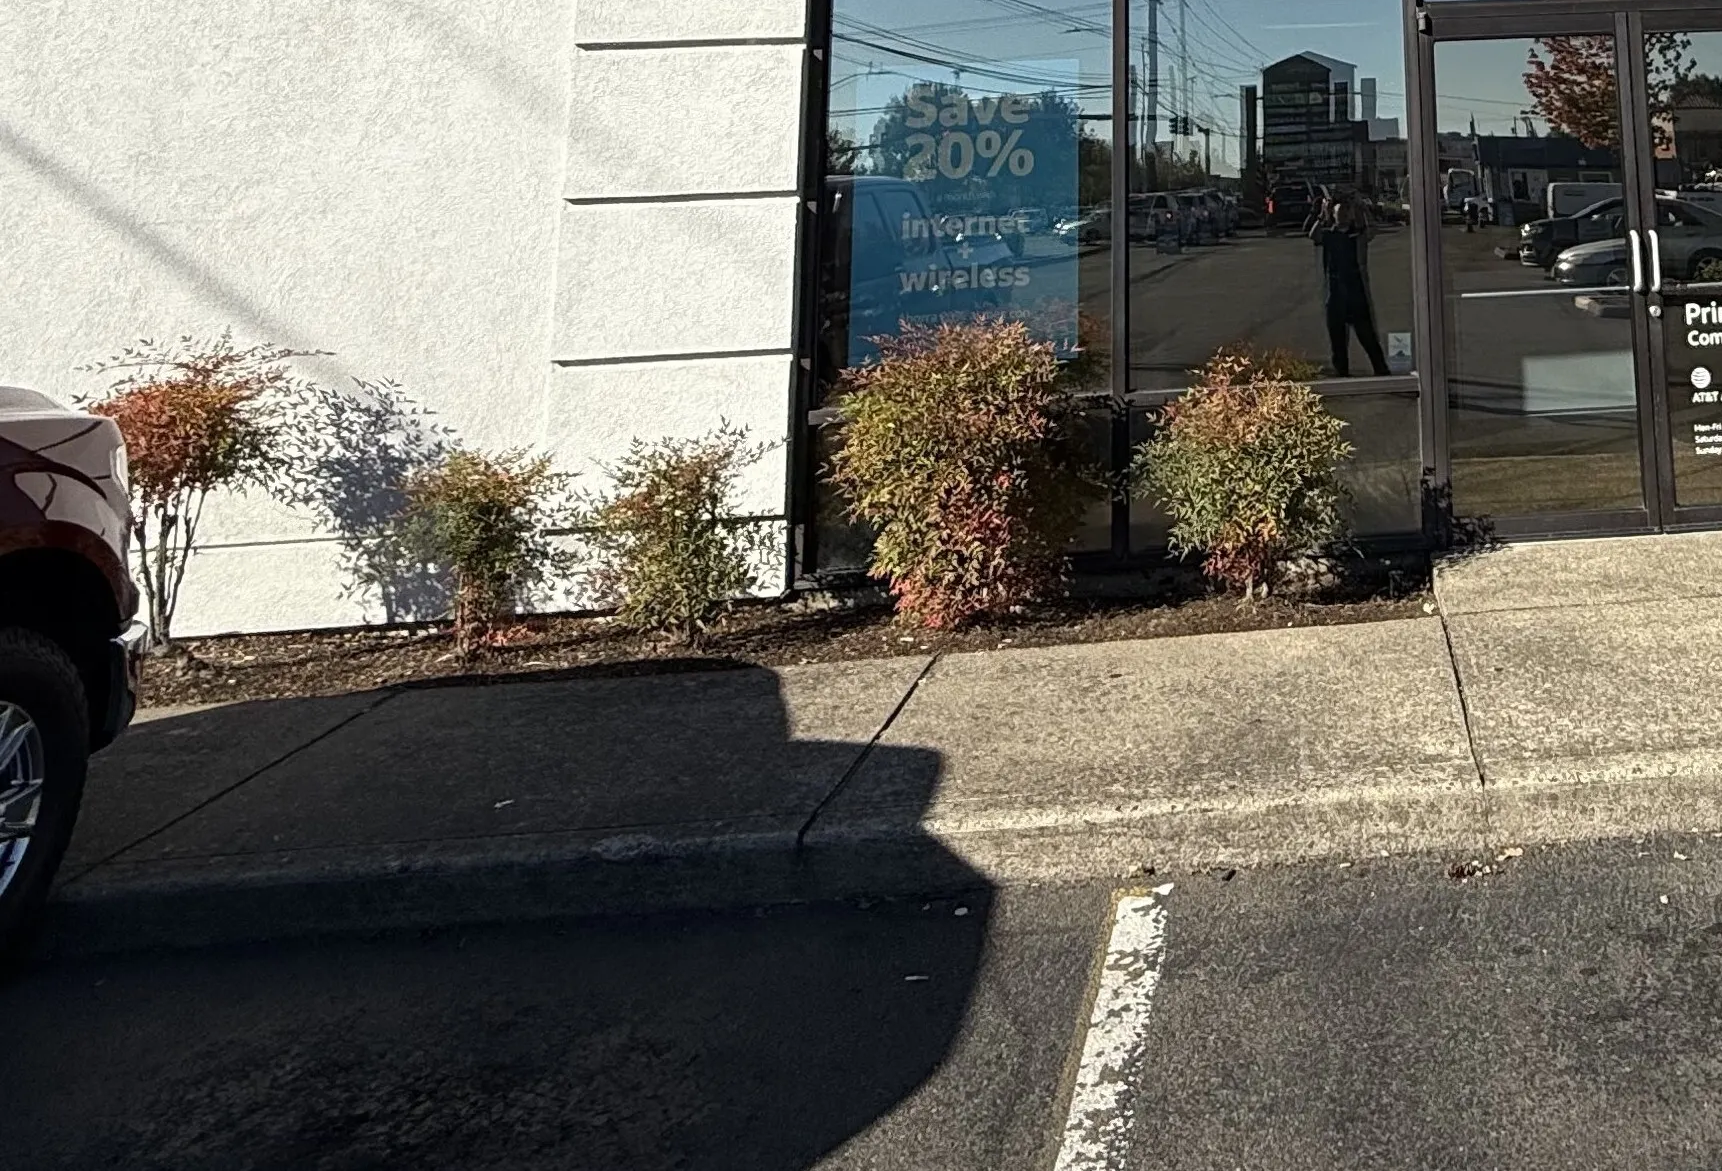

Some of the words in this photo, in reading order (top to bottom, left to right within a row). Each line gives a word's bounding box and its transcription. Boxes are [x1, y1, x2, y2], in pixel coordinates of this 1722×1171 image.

[905, 83, 1031, 128] Save
[902, 130, 1034, 181] 20%
[902, 212, 1030, 238] internet
[900, 262, 1030, 292] wireless
[1692, 391, 1719, 403] AT&T
[1695, 446, 1722, 455] Sunday
